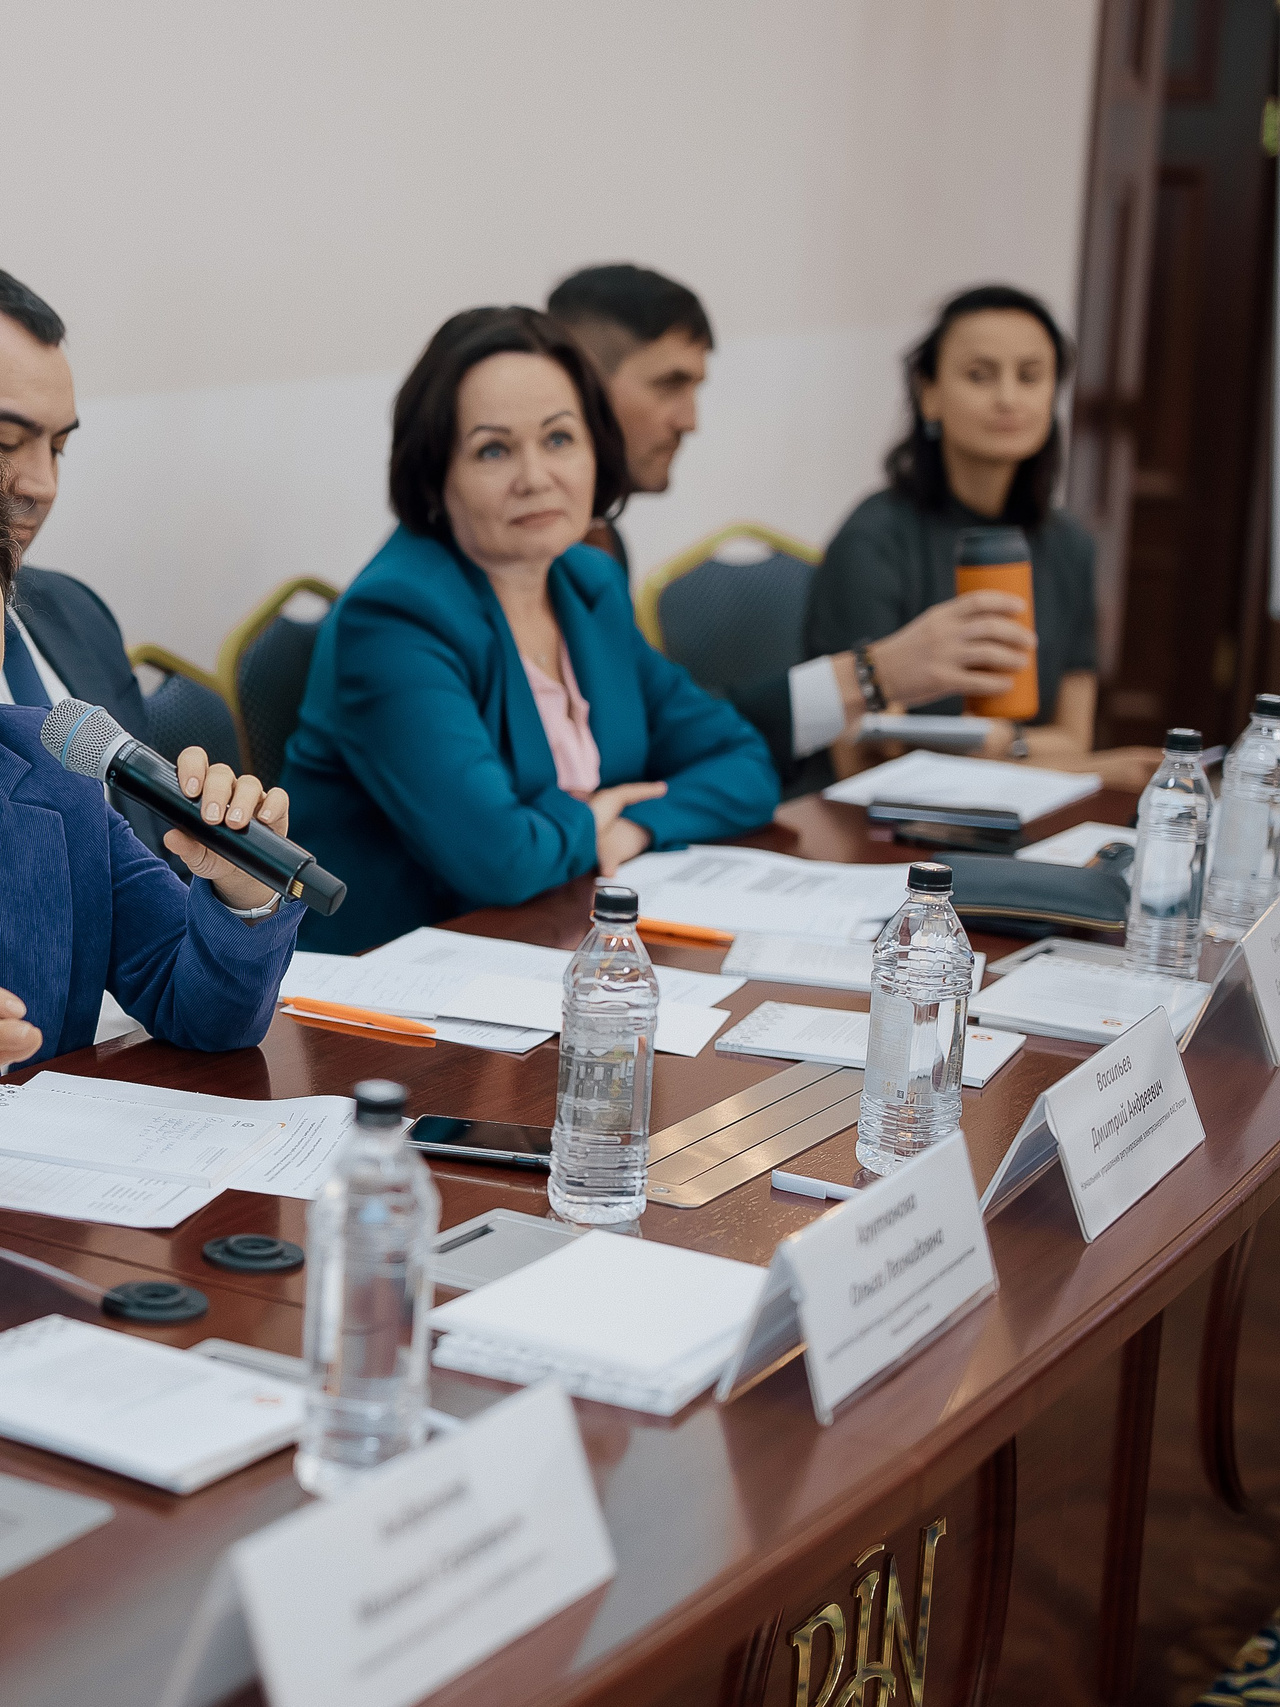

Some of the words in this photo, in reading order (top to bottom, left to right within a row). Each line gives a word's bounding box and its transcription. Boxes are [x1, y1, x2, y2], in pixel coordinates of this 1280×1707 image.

[1096, 1055, 1133, 1092] Васильев
[1091, 1102, 1129, 1153] Дмитрий
[1126, 1078, 1164, 1120] Андреевич
